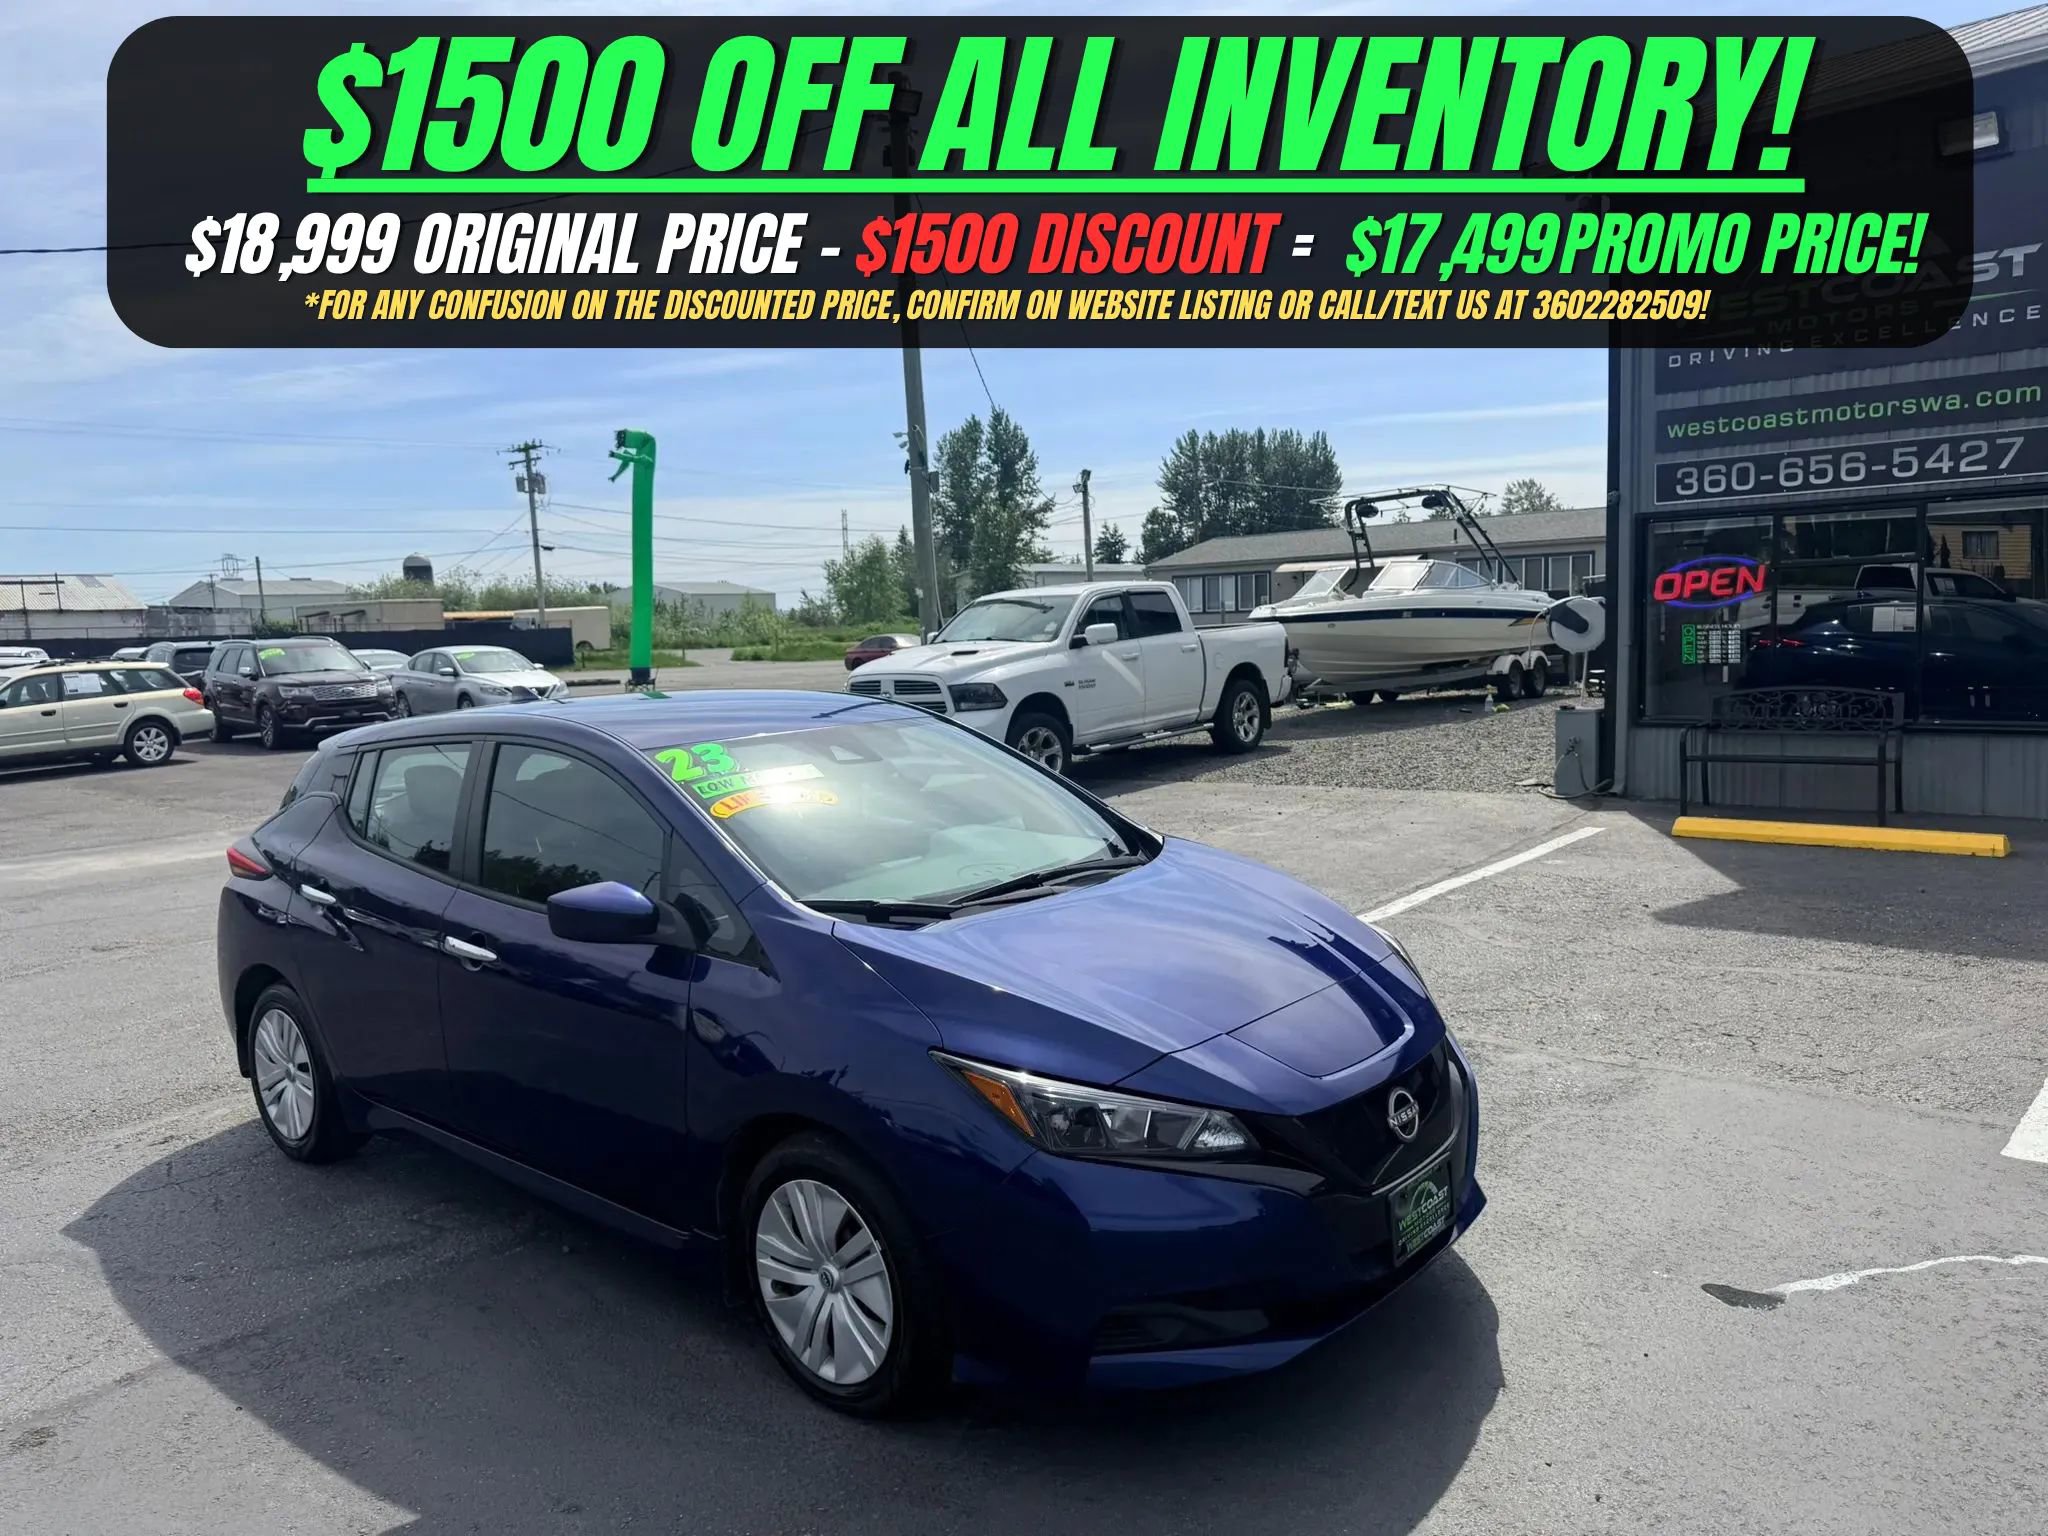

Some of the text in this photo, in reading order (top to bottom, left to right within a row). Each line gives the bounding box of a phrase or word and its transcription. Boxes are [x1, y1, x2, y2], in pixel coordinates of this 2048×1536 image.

[1668, 339, 1795, 368] DRIVING
[1667, 385, 2042, 438] westcoastmotorswa.com
[1675, 437, 2025, 495] 360-656-5427
[1653, 564, 1767, 601] OPEN
[655, 743, 737, 781] 23
[697, 779, 734, 796] LOW
